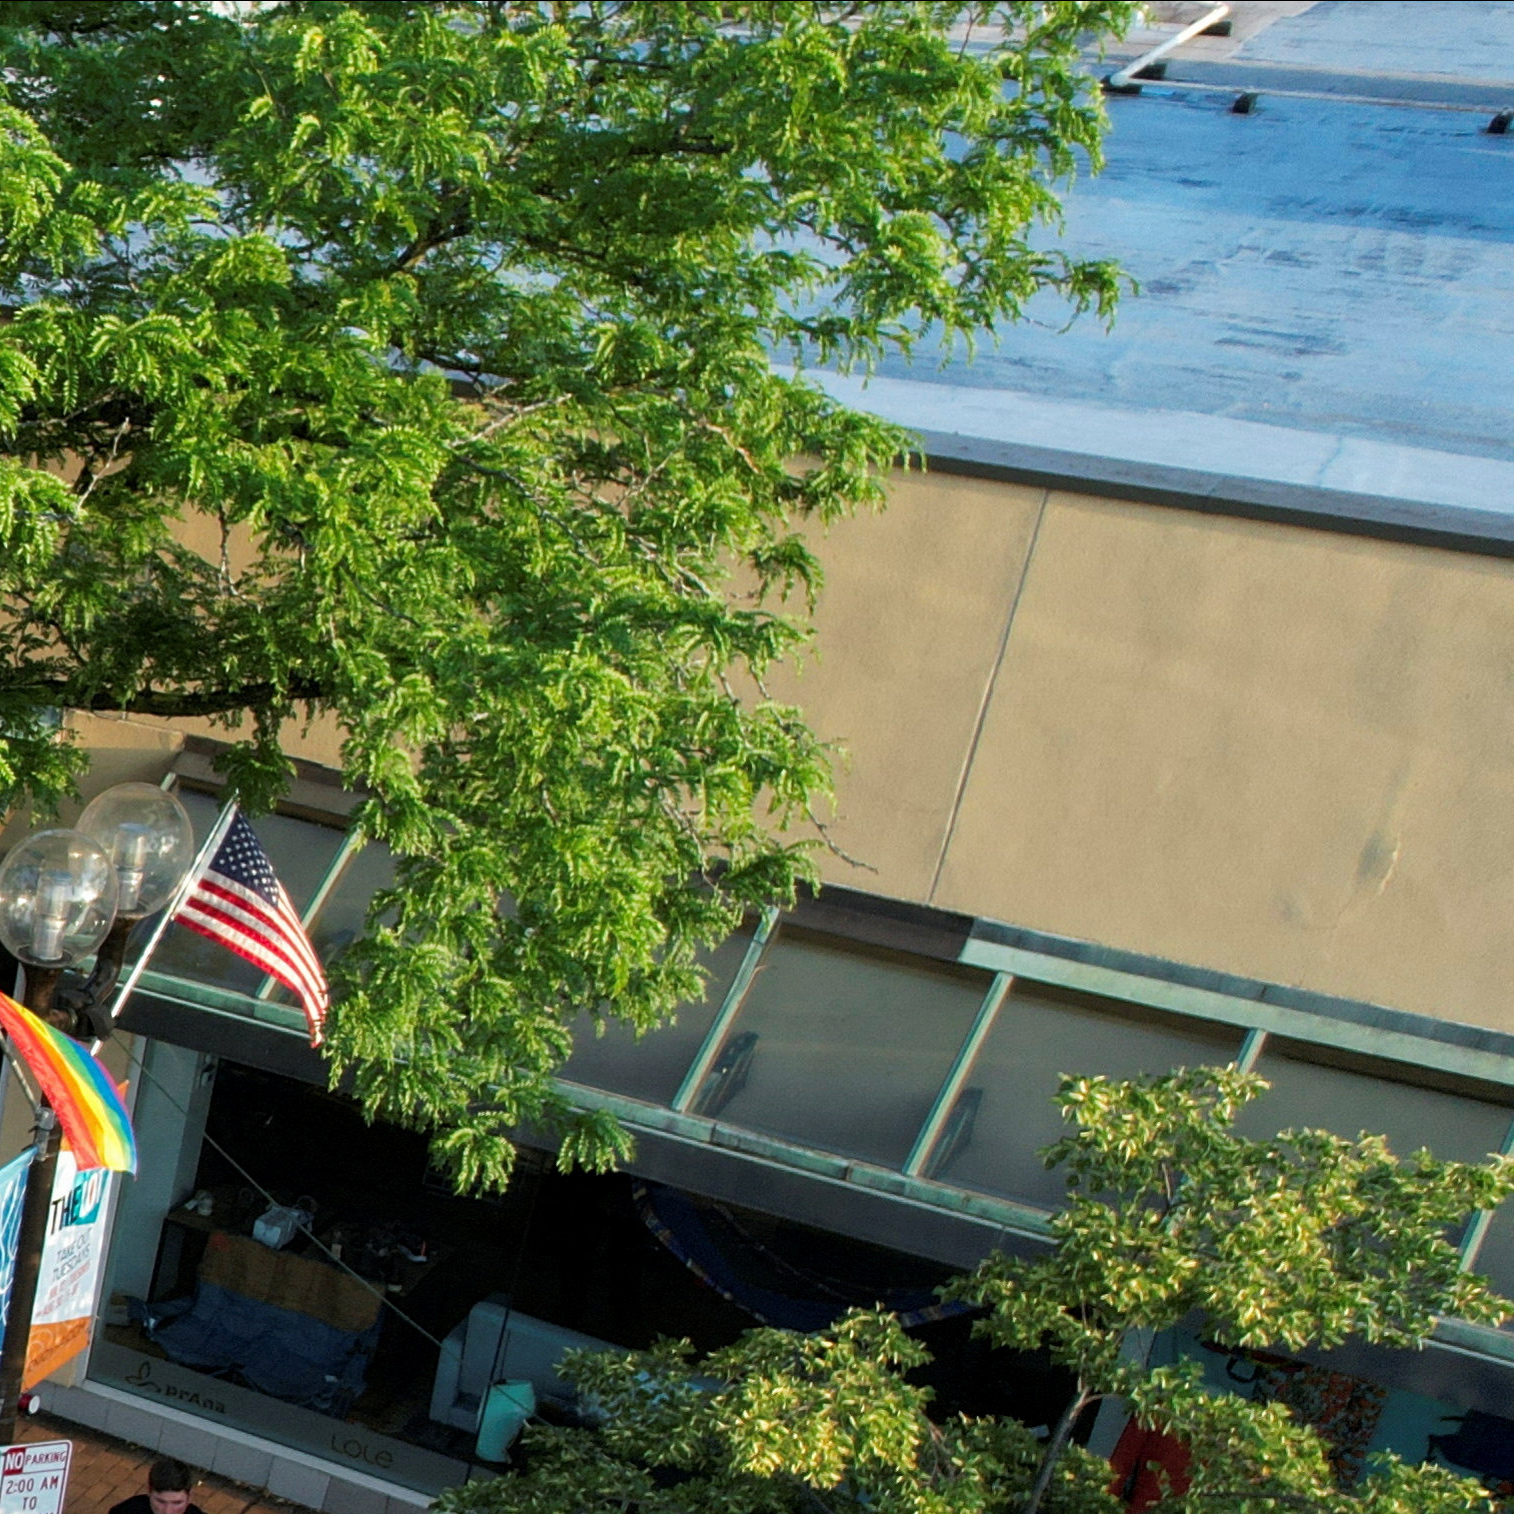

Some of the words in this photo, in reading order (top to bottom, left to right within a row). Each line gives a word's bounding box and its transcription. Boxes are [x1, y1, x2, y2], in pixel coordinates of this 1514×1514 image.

[52, 1184, 81, 1235] THE
[5, 1453, 22, 1470] NO
[25, 1451, 67, 1466] PARKING
[6, 1478, 34, 1494] 2:00
[40, 1475, 59, 1490] AM
[22, 1496, 37, 1510] TO
